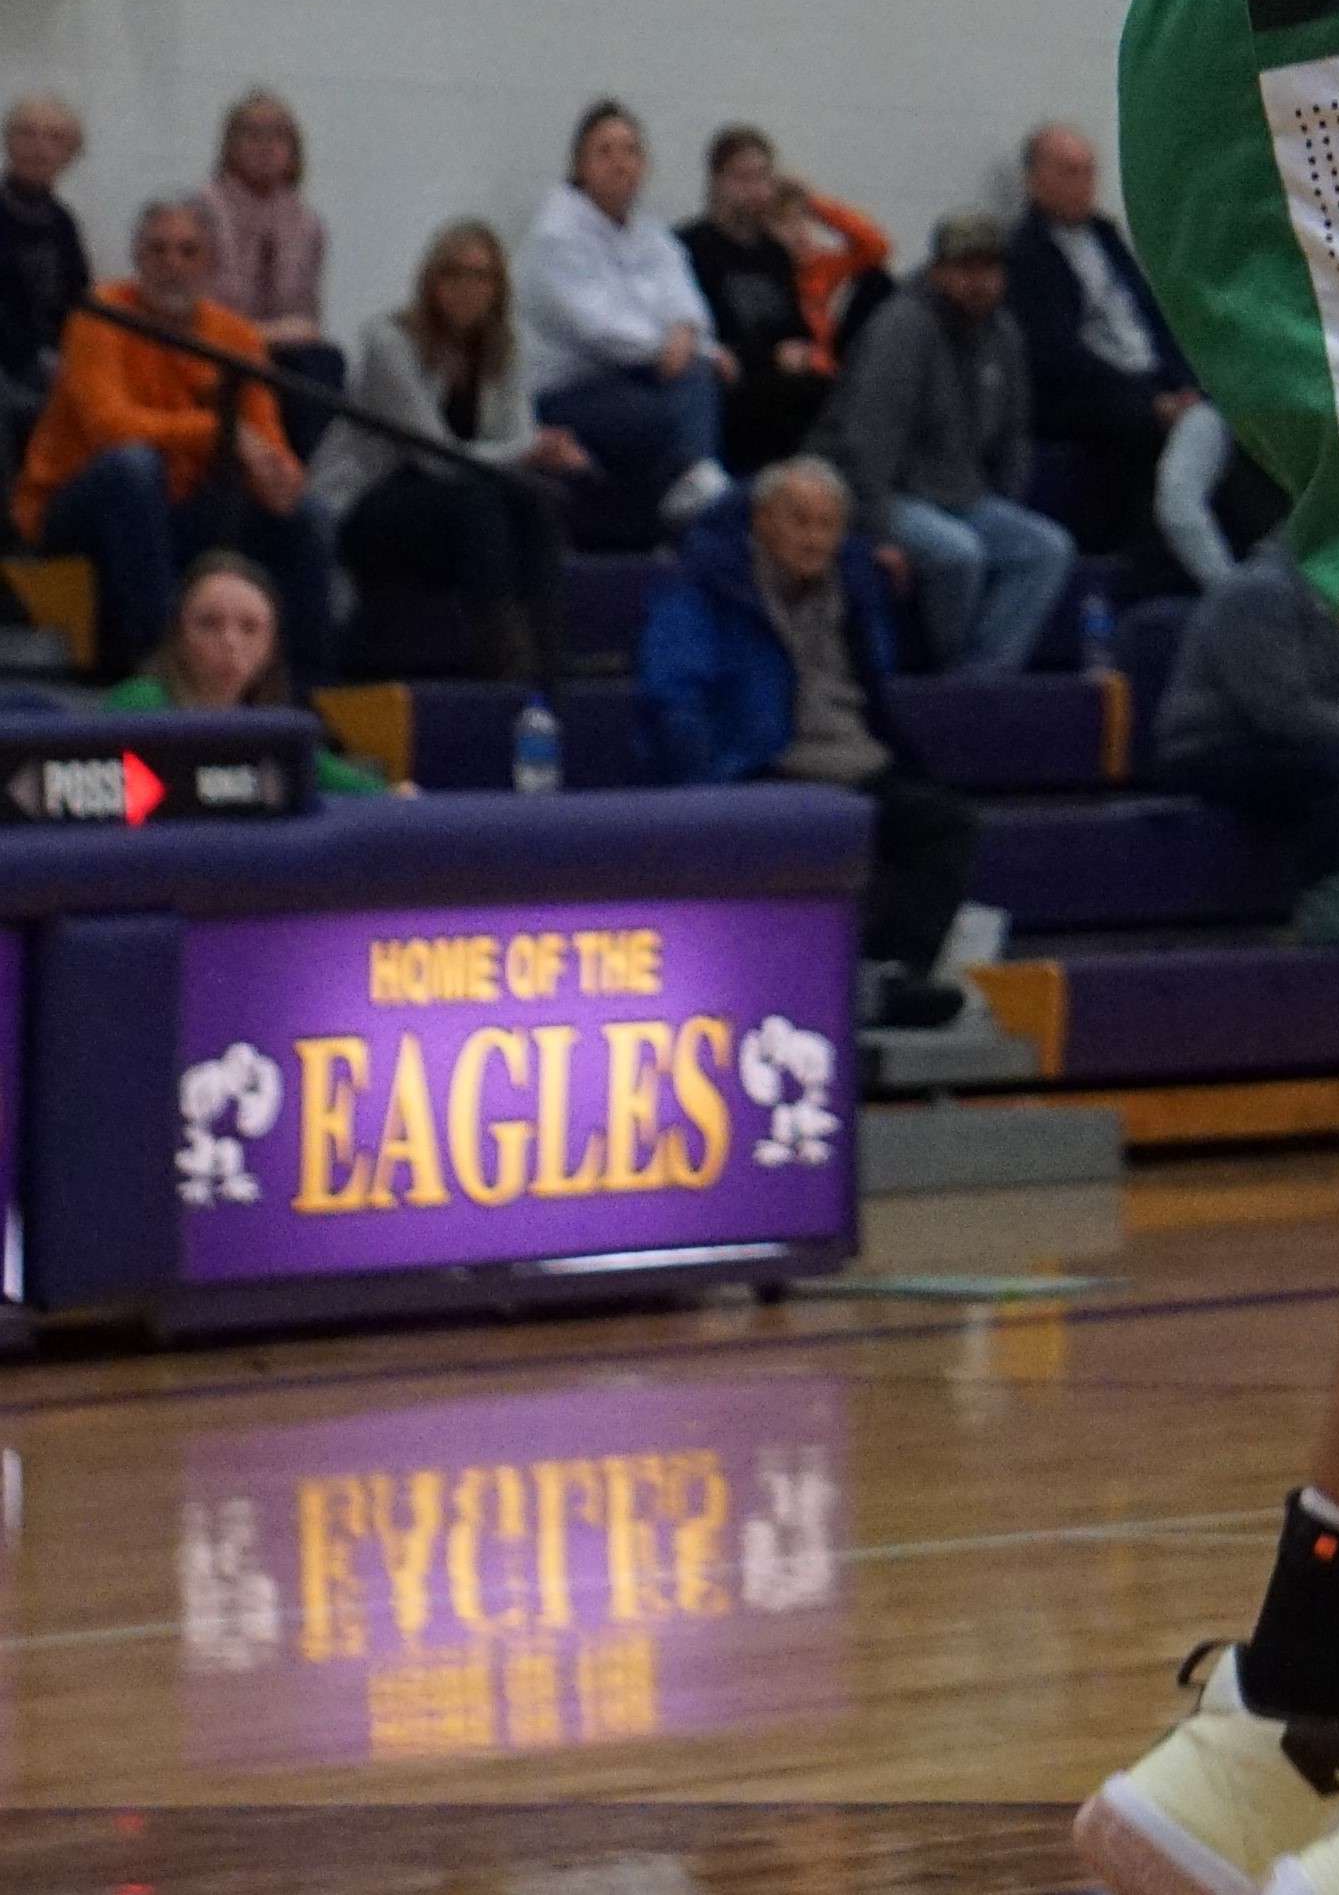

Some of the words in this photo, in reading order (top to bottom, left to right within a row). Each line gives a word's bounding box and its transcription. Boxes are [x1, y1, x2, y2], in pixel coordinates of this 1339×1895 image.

[43, 757, 124, 818] POSS
[369, 936, 500, 1006] HOME
[506, 932, 568, 1000] OF
[572, 927, 664, 996] THE
[290, 1014, 736, 1216] EAGLES
